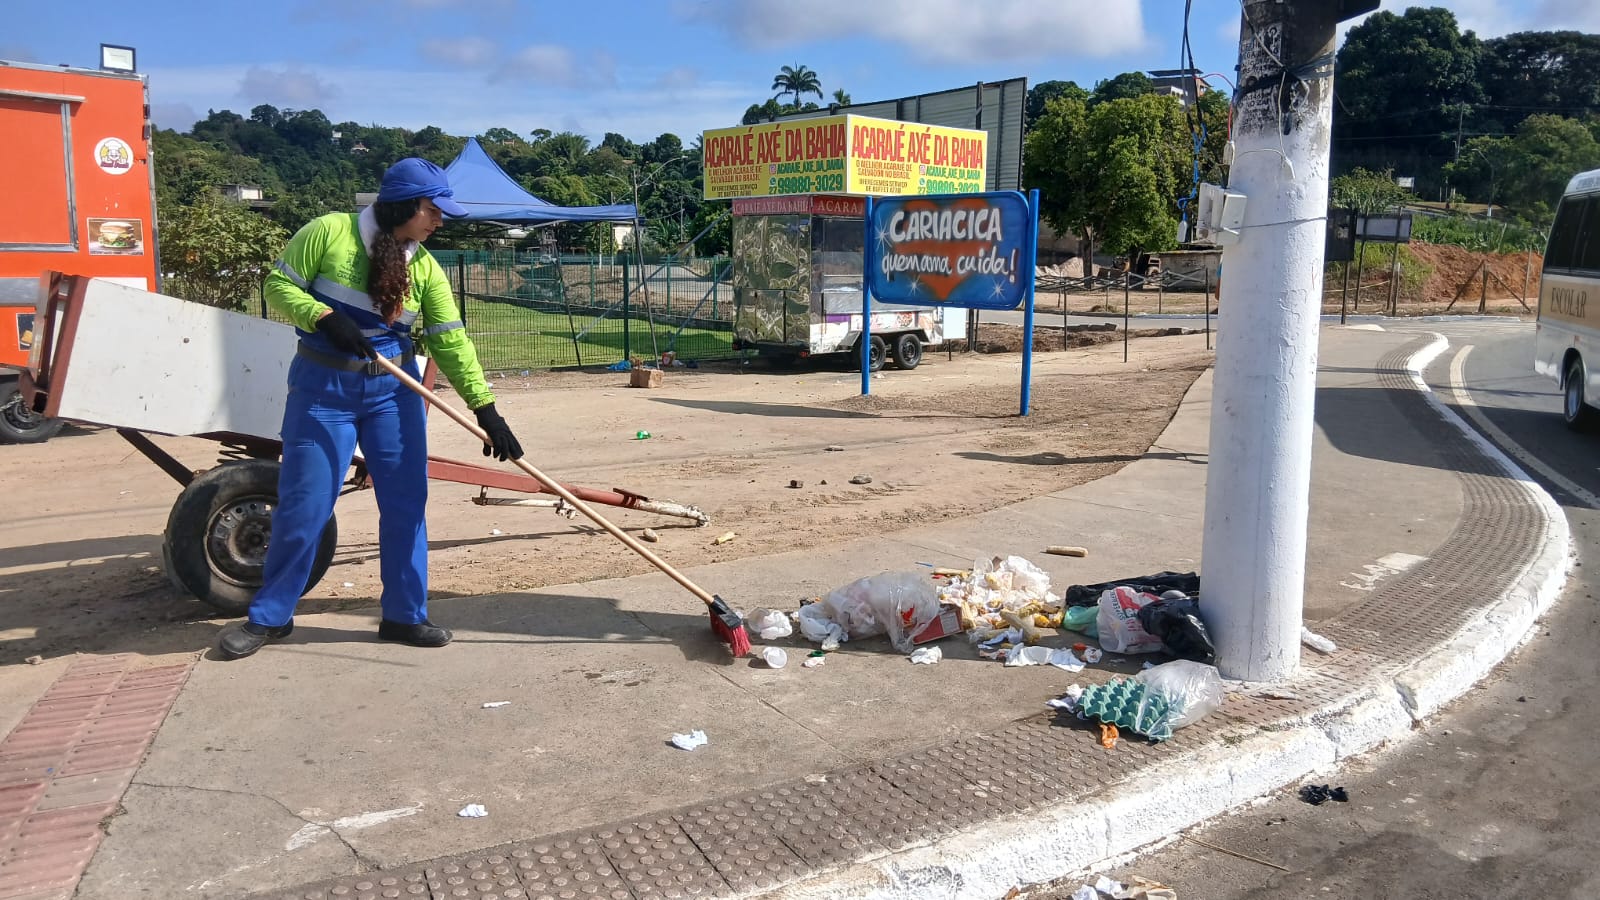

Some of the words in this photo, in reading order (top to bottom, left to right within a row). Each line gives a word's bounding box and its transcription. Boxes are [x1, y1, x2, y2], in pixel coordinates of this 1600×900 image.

[704, 127, 754, 168] ACARAJÉ
[757, 124, 782, 164] AXÉ
[785, 128, 804, 161] DA
[806, 124, 847, 159] BAHIA
[851, 124, 905, 163] ACARAJÉ
[907, 127, 931, 165] AXÉ
[933, 134, 949, 166] DA
[951, 136, 983, 169] BAHIA
[858, 168, 884, 178] SALVADOR
[885, 170, 892, 178] NO
[893, 171, 910, 179] BRASIL
[861, 160, 882, 169] MELHOR
[906, 163, 912, 172] DE
[769, 186, 777, 195] 27
[777, 173, 843, 194] 99880-3029
[818, 200, 864, 214] ACARAJ
[889, 207, 1002, 242] CARIACICA
[956, 246, 1016, 283] cuida!
[1550, 287, 1587, 319] ESCOLAR
